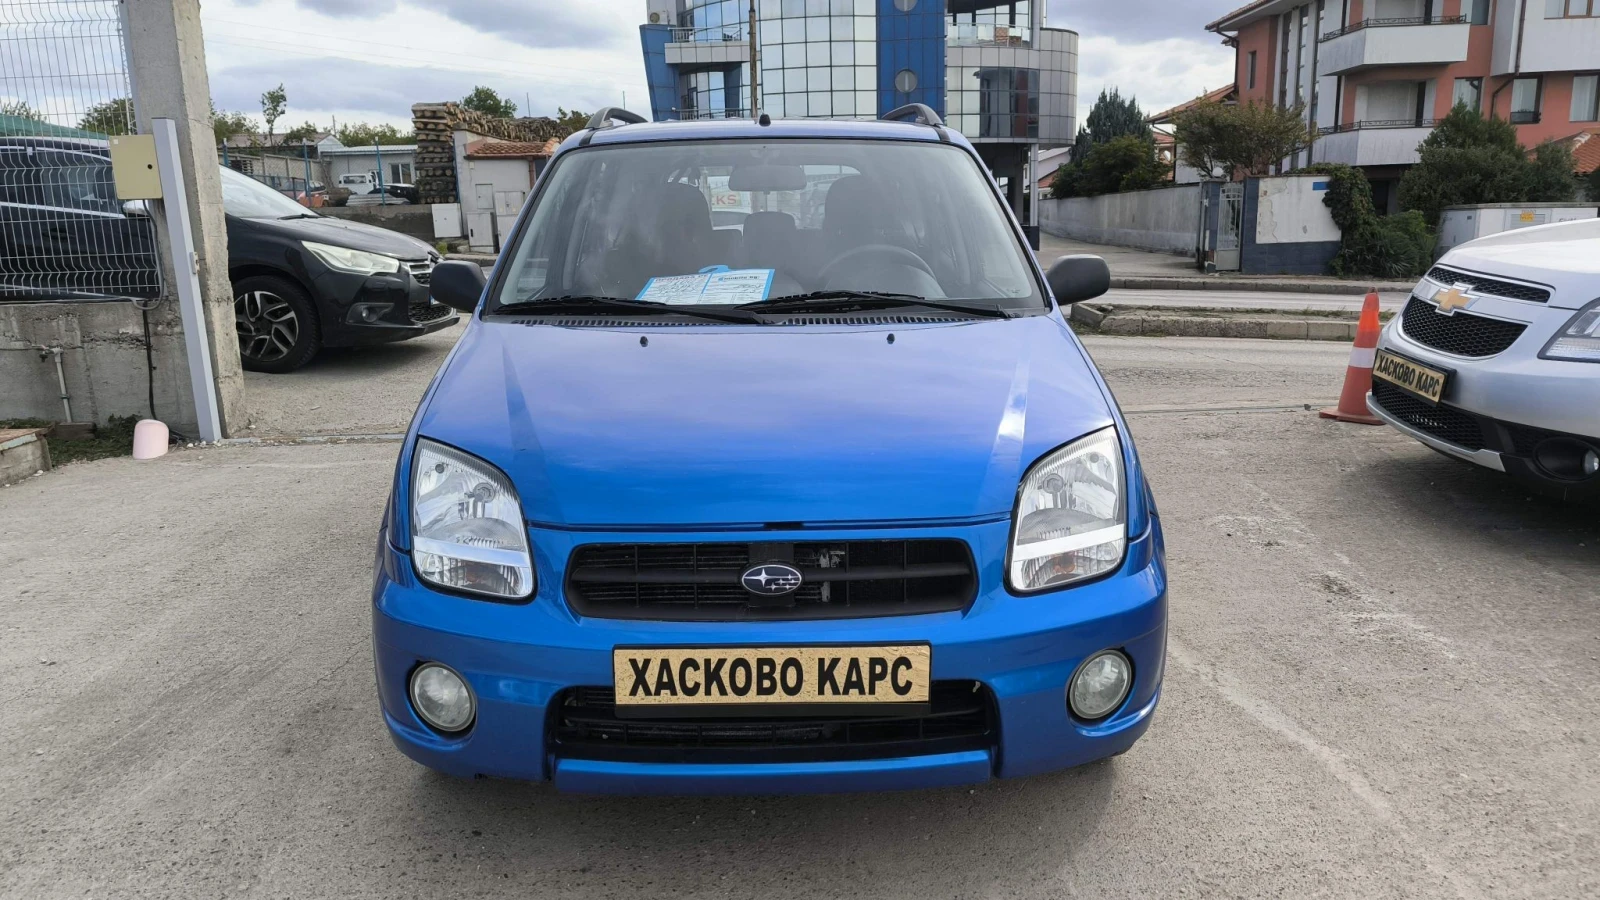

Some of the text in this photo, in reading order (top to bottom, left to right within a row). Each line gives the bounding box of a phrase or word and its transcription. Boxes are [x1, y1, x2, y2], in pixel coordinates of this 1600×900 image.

[712, 194, 737, 205] KS
[1376, 354, 1440, 398] ХАСКОВО КАРС
[628, 656, 913, 696] ХАСКОВО КАРС
